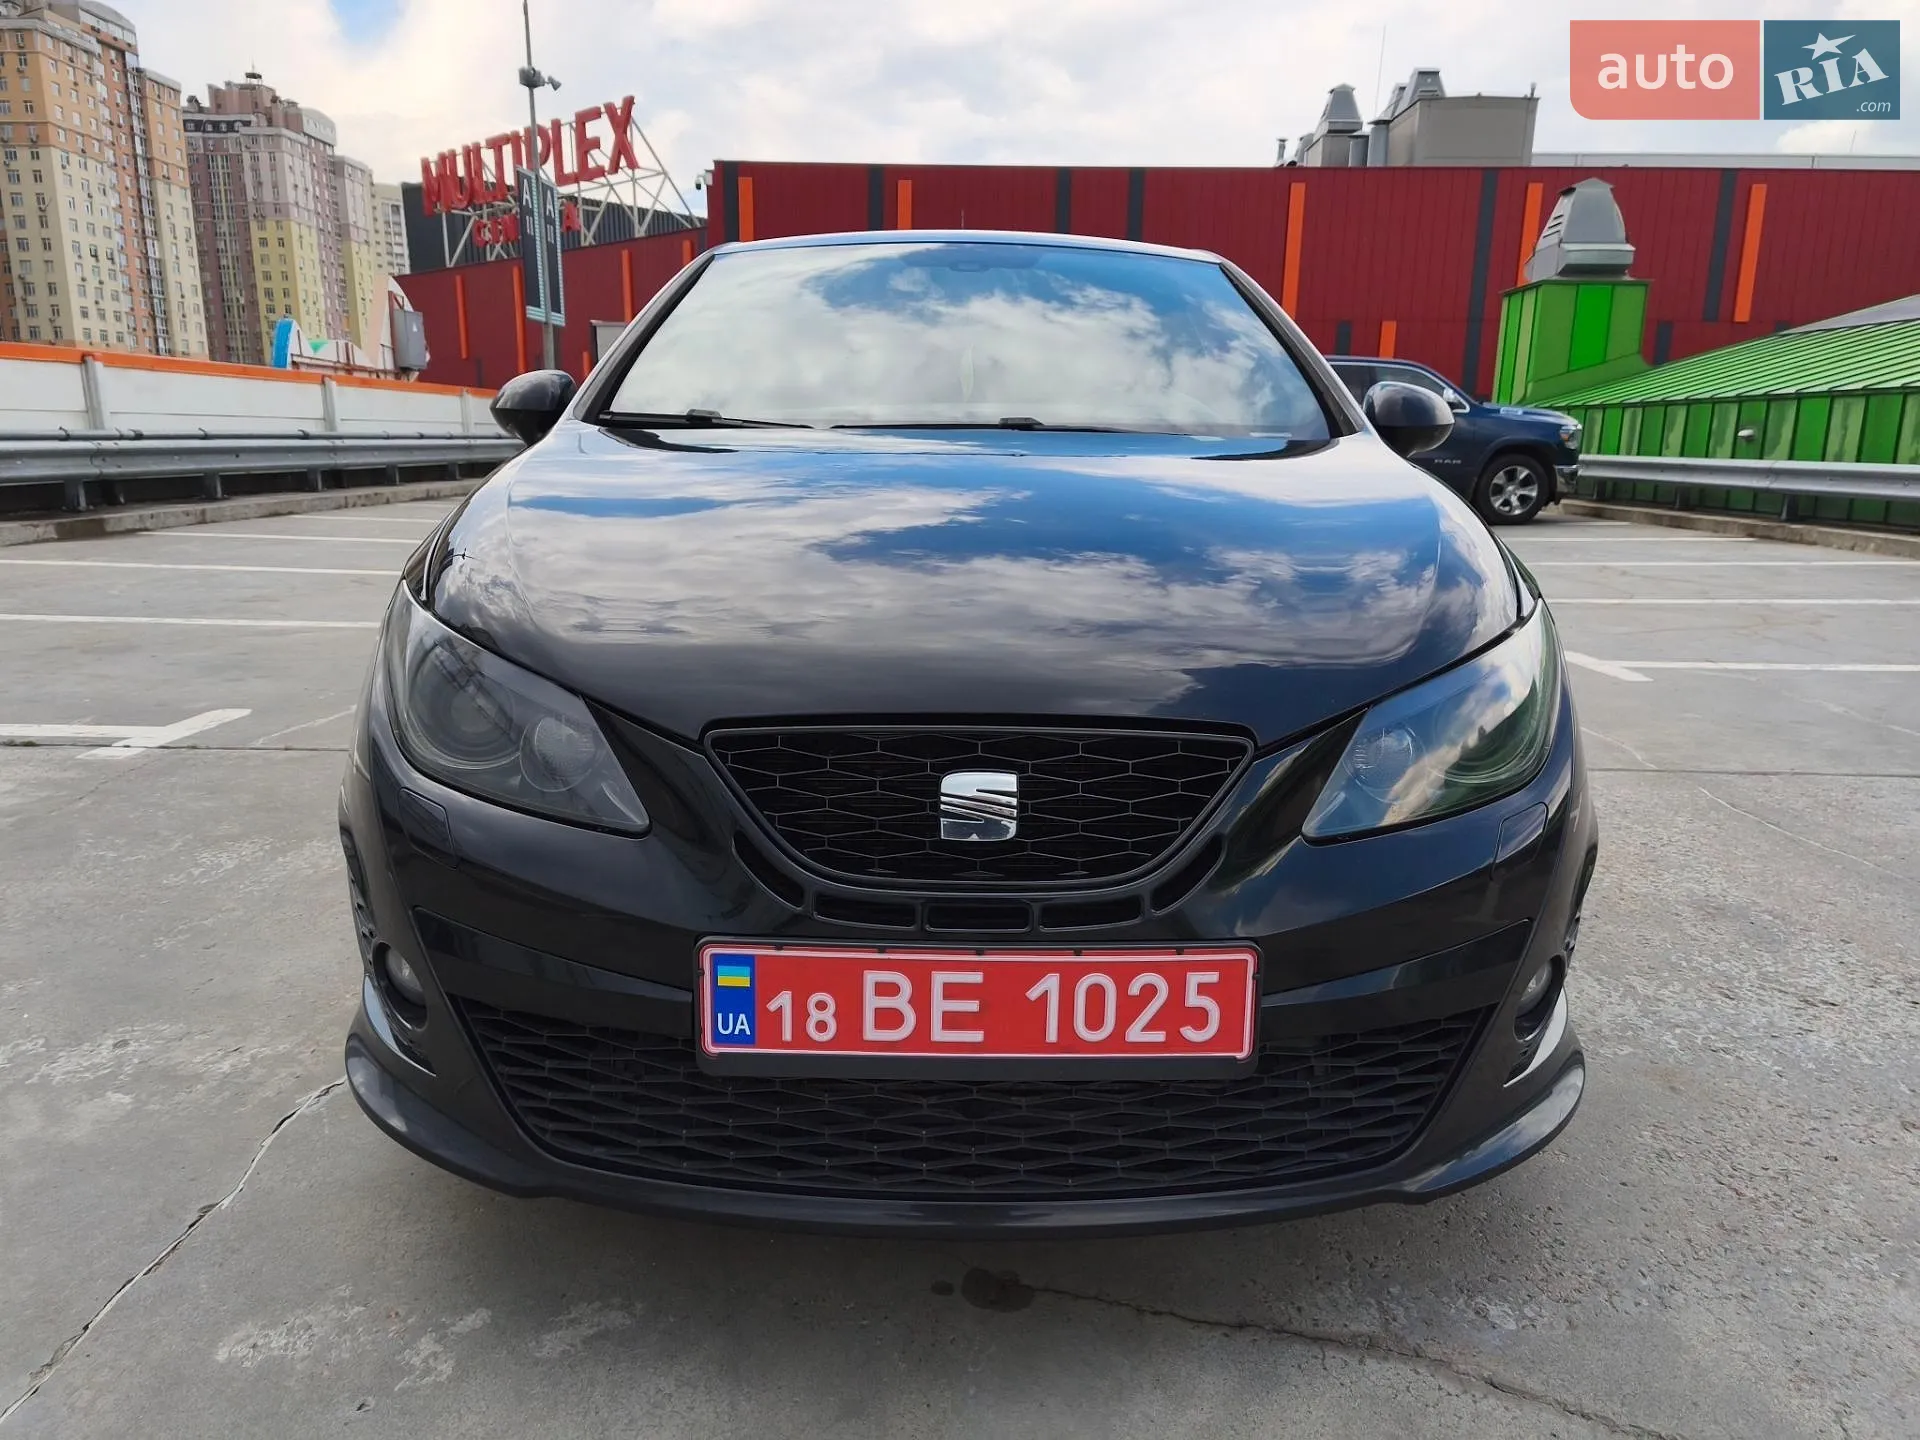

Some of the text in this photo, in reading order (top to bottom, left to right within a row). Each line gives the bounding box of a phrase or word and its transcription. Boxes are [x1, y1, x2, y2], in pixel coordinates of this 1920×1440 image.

[420, 95, 639, 217] MULTIPLEX
[522, 178, 532, 209] A
[716, 969, 1221, 1044] UA 18 BE 1025
